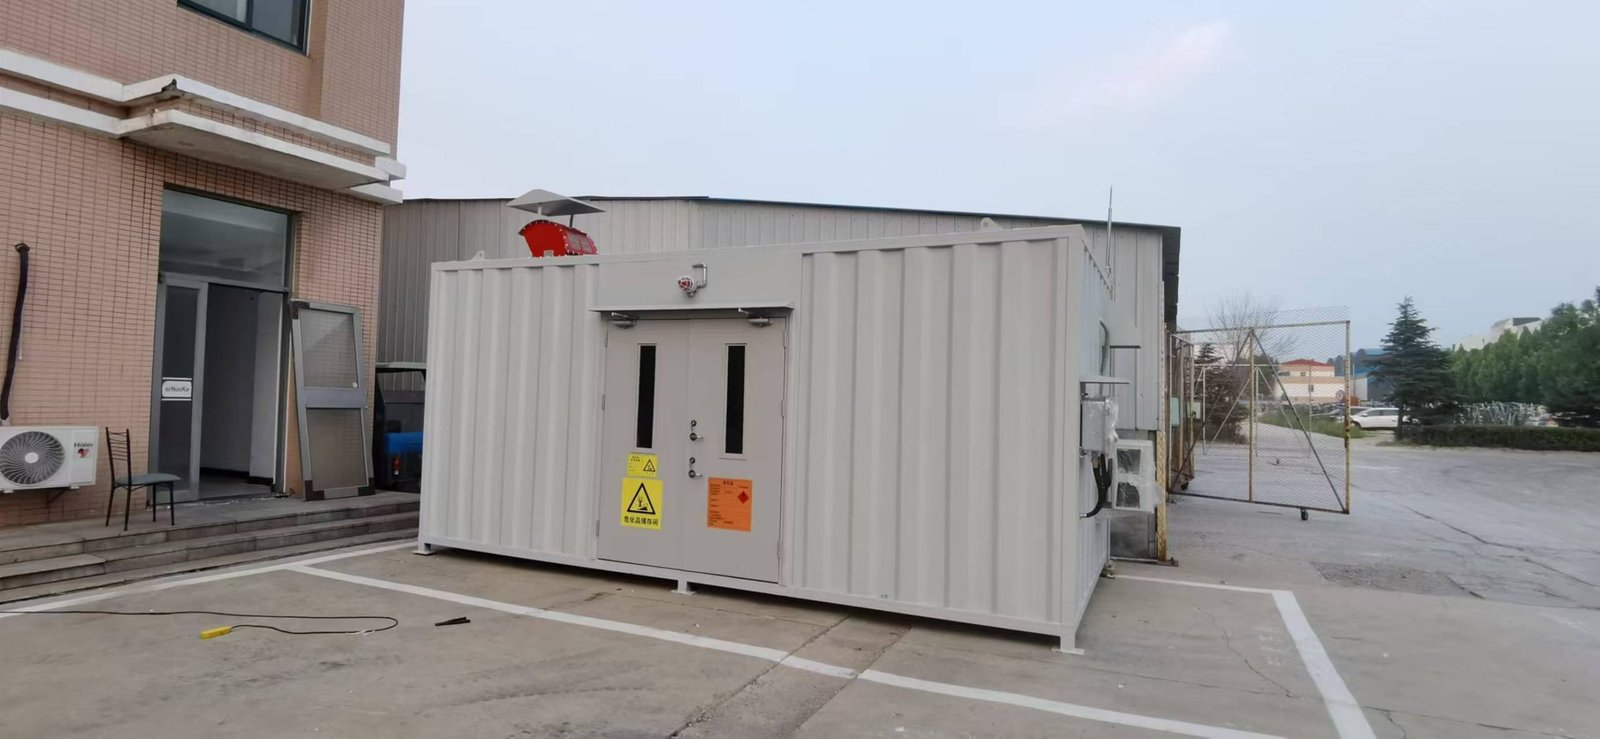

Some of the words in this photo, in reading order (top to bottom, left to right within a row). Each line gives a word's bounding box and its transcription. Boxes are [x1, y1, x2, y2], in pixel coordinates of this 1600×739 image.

[624, 515, 659, 526] 危化品储存间
